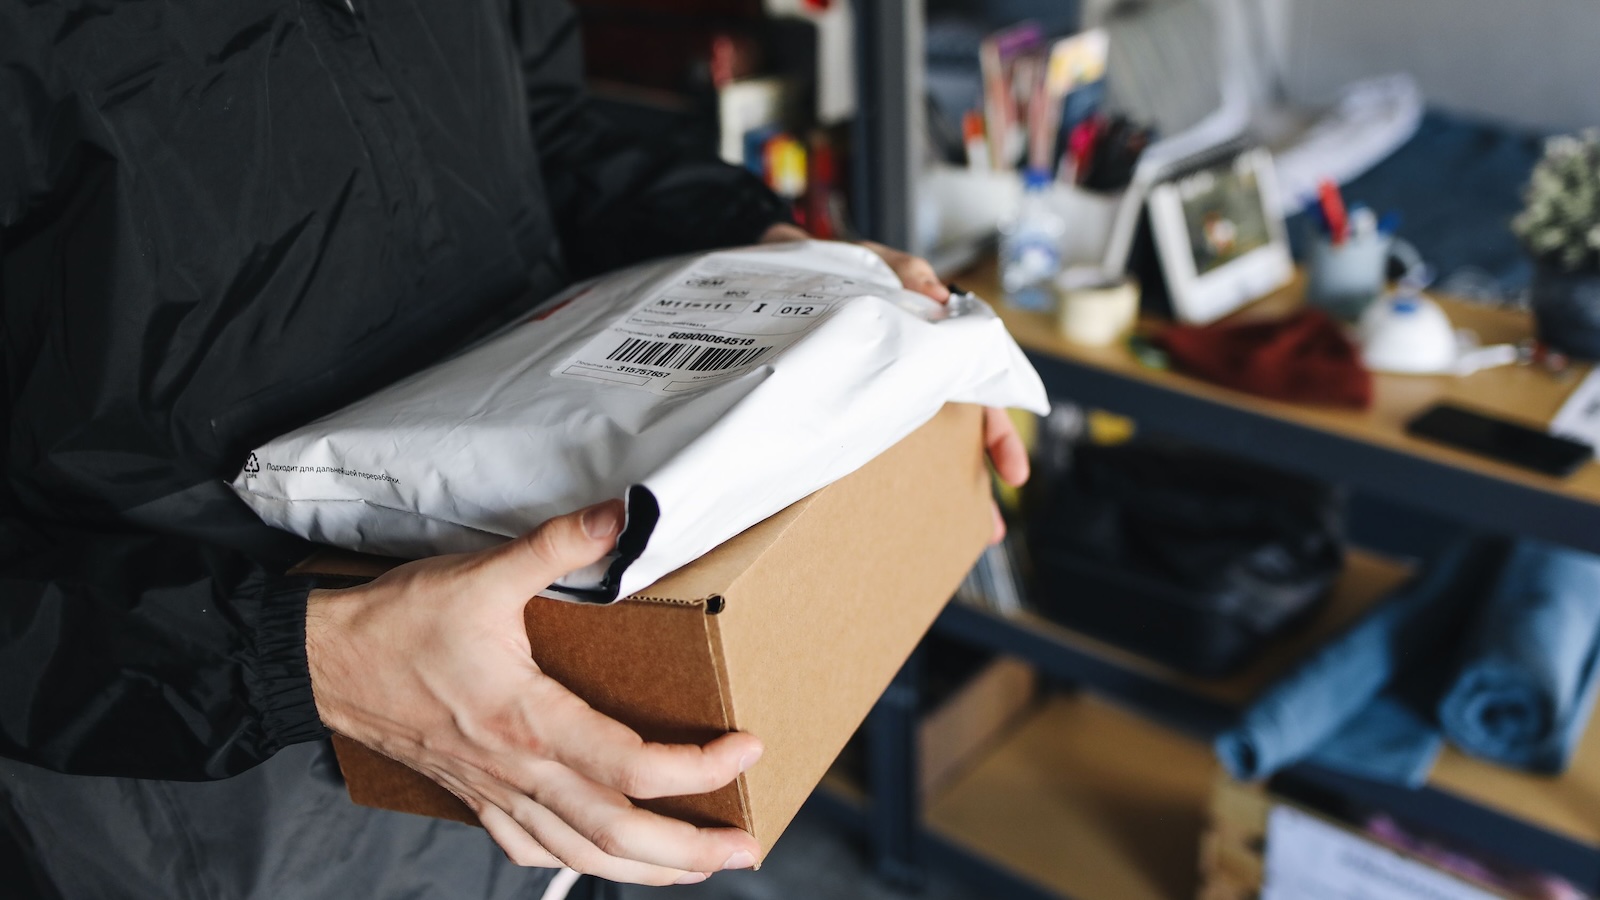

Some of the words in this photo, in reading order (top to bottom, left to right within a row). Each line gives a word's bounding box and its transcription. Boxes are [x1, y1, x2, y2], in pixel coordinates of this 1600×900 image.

[780, 306, 814, 315] 012
[668, 331, 756, 346] 60900064518
[617, 365, 671, 379] 315757657
[266, 462, 298, 472] Подходит
[316, 465, 358, 477] дальнейшей
[358, 471, 401, 485] переработки.
